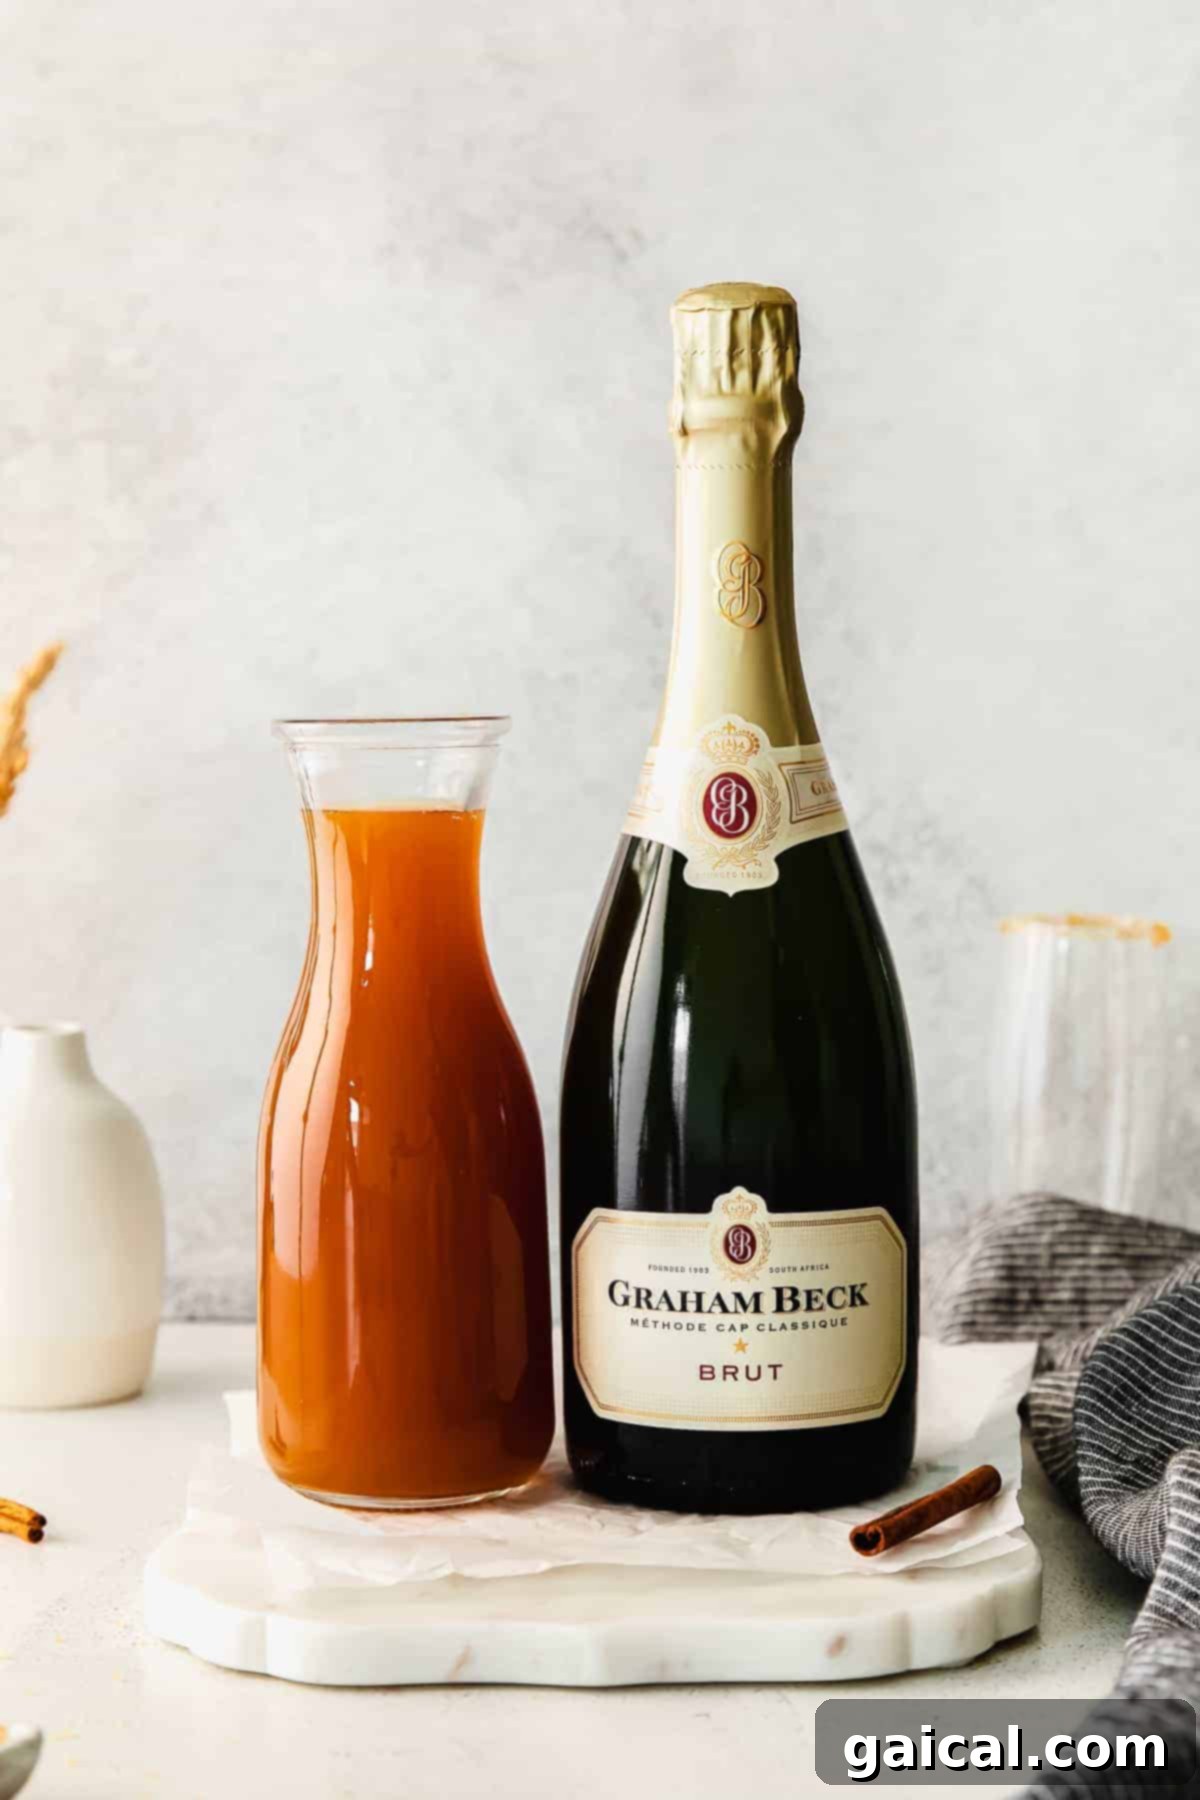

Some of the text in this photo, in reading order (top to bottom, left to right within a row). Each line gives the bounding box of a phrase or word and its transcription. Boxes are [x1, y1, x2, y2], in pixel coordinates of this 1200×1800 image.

[769, 1263, 830, 1274] SOUTH AFRICA
[607, 1279, 869, 1315] GRAHAM BECK
[630, 1317, 849, 1333] MÉTHODE CAP CLASSIQUE
[699, 1364, 784, 1381] BRUT
